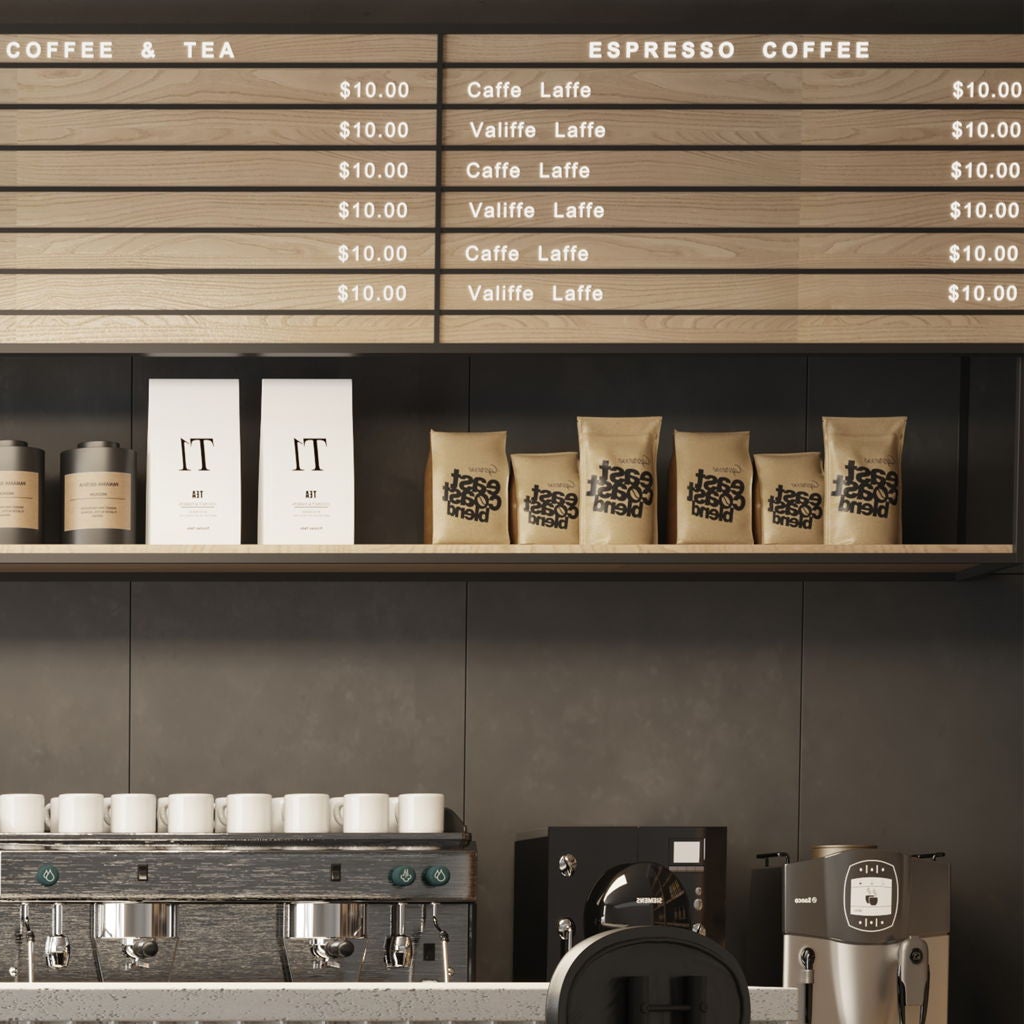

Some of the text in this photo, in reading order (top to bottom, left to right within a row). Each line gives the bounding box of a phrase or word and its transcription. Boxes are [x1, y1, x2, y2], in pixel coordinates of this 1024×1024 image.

[6, 41, 235, 58] COFFEE & TEA
[588, 41, 869, 58] ESPRESSO COFFEE
[340, 81, 408, 99] $10.00
[467, 81, 1022, 99] Caffe Laffe $10.00
[340, 121, 408, 139] $10.00
[470, 121, 1021, 139] Valiffe Laffe $10.00
[339, 162, 407, 179] $10.00
[467, 161, 1020, 180] Caffe Laffe $10.00
[339, 201, 407, 219] $10.00
[469, 201, 1019, 219] Valiffe Laffe $10.00
[338, 245, 406, 262] $10.00
[465, 244, 1018, 262] Caffe Laffe $10.00
[338, 285, 406, 302] $10.00
[949, 284, 1017, 302] $10.00
